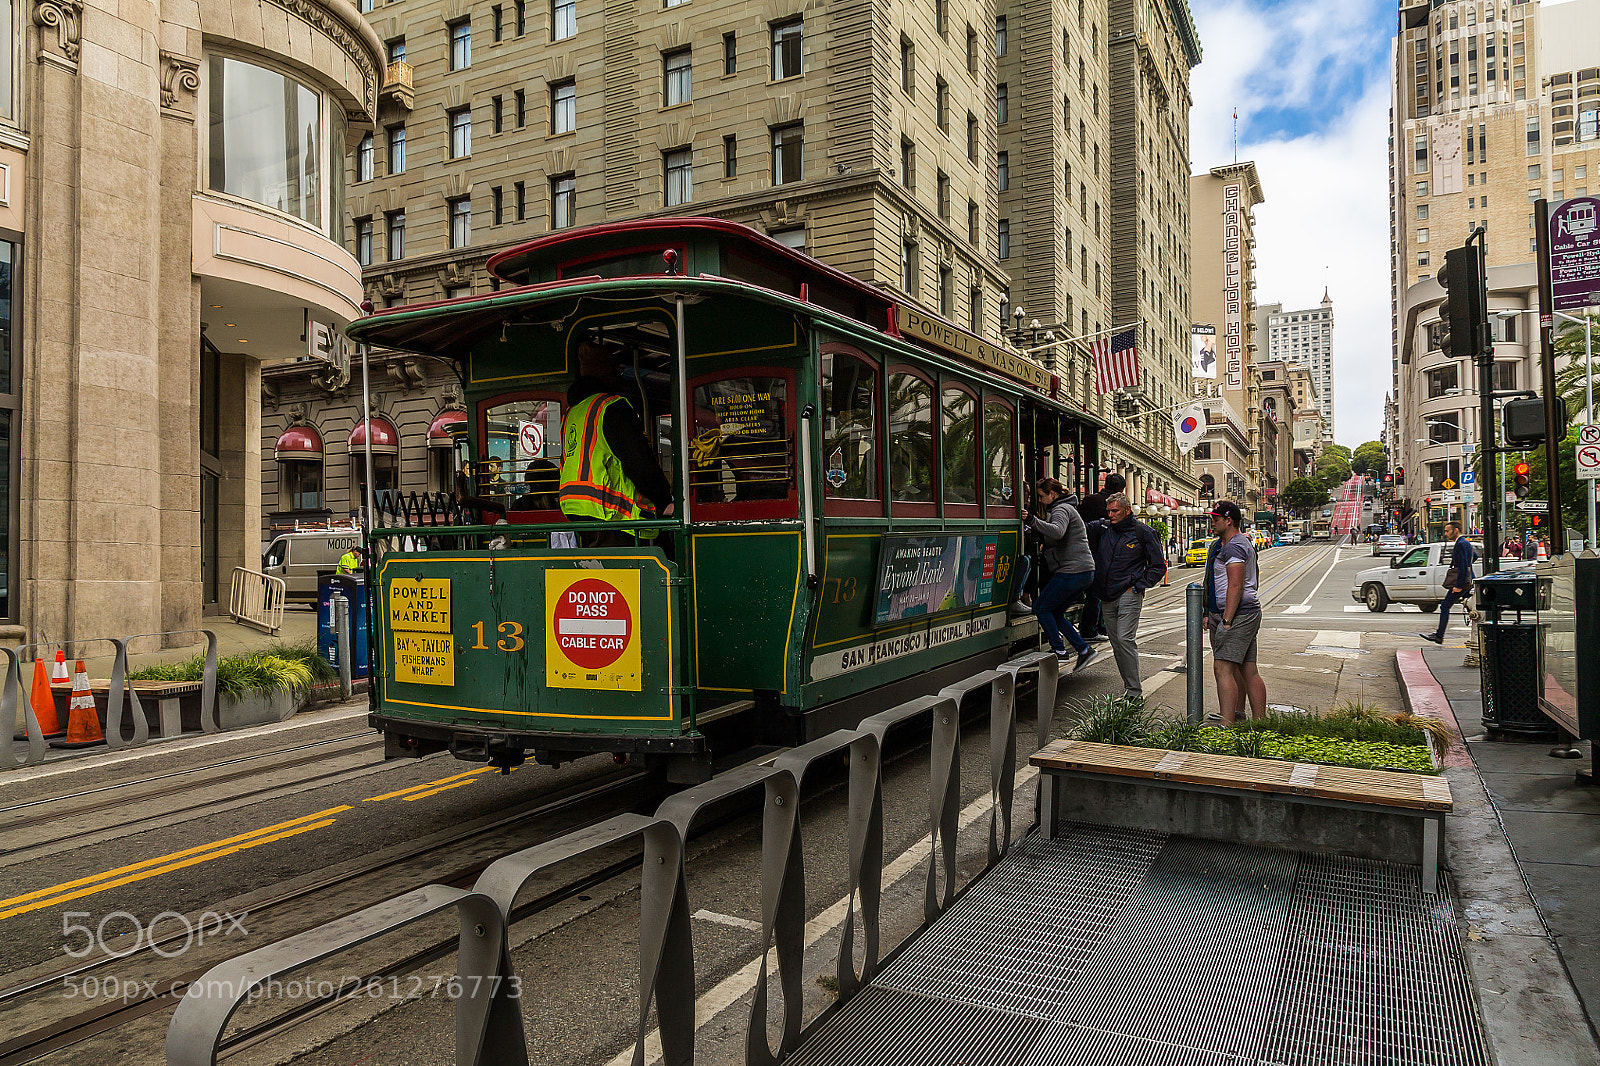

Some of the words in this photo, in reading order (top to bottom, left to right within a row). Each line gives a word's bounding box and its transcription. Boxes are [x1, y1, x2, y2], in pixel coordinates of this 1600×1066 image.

[1225, 185, 1240, 314] CHANCELLOR
[906, 313, 972, 354] POWELL
[978, 346, 986, 361] &
[992, 350, 1031, 380] MASON
[1226, 322, 1240, 386] HOTEL
[712, 396, 726, 405] FARE
[742, 394, 756, 402] ONE
[896, 548, 921, 560] AWAKING
[922, 546, 943, 558] BEAUTY
[393, 587, 447, 600] POWELL
[831, 577, 857, 604] 13
[408, 600, 434, 610] AND
[568, 592, 587, 604] DO
[589, 592, 616, 604] NOT
[392, 610, 448, 623] MARKET
[576, 604, 608, 616] PASS
[471, 620, 524, 652] 13
[562, 636, 596, 648] CABLE
[600, 638, 624, 650] CAR
[396, 638, 410, 651] BAY
[422, 638, 450, 654] TAYLOR
[842, 651, 864, 670] SAN
[868, 634, 920, 662] FRANCISCO
[402, 654, 446, 666] FISHERMANS
[412, 666, 434, 676] WHARF
